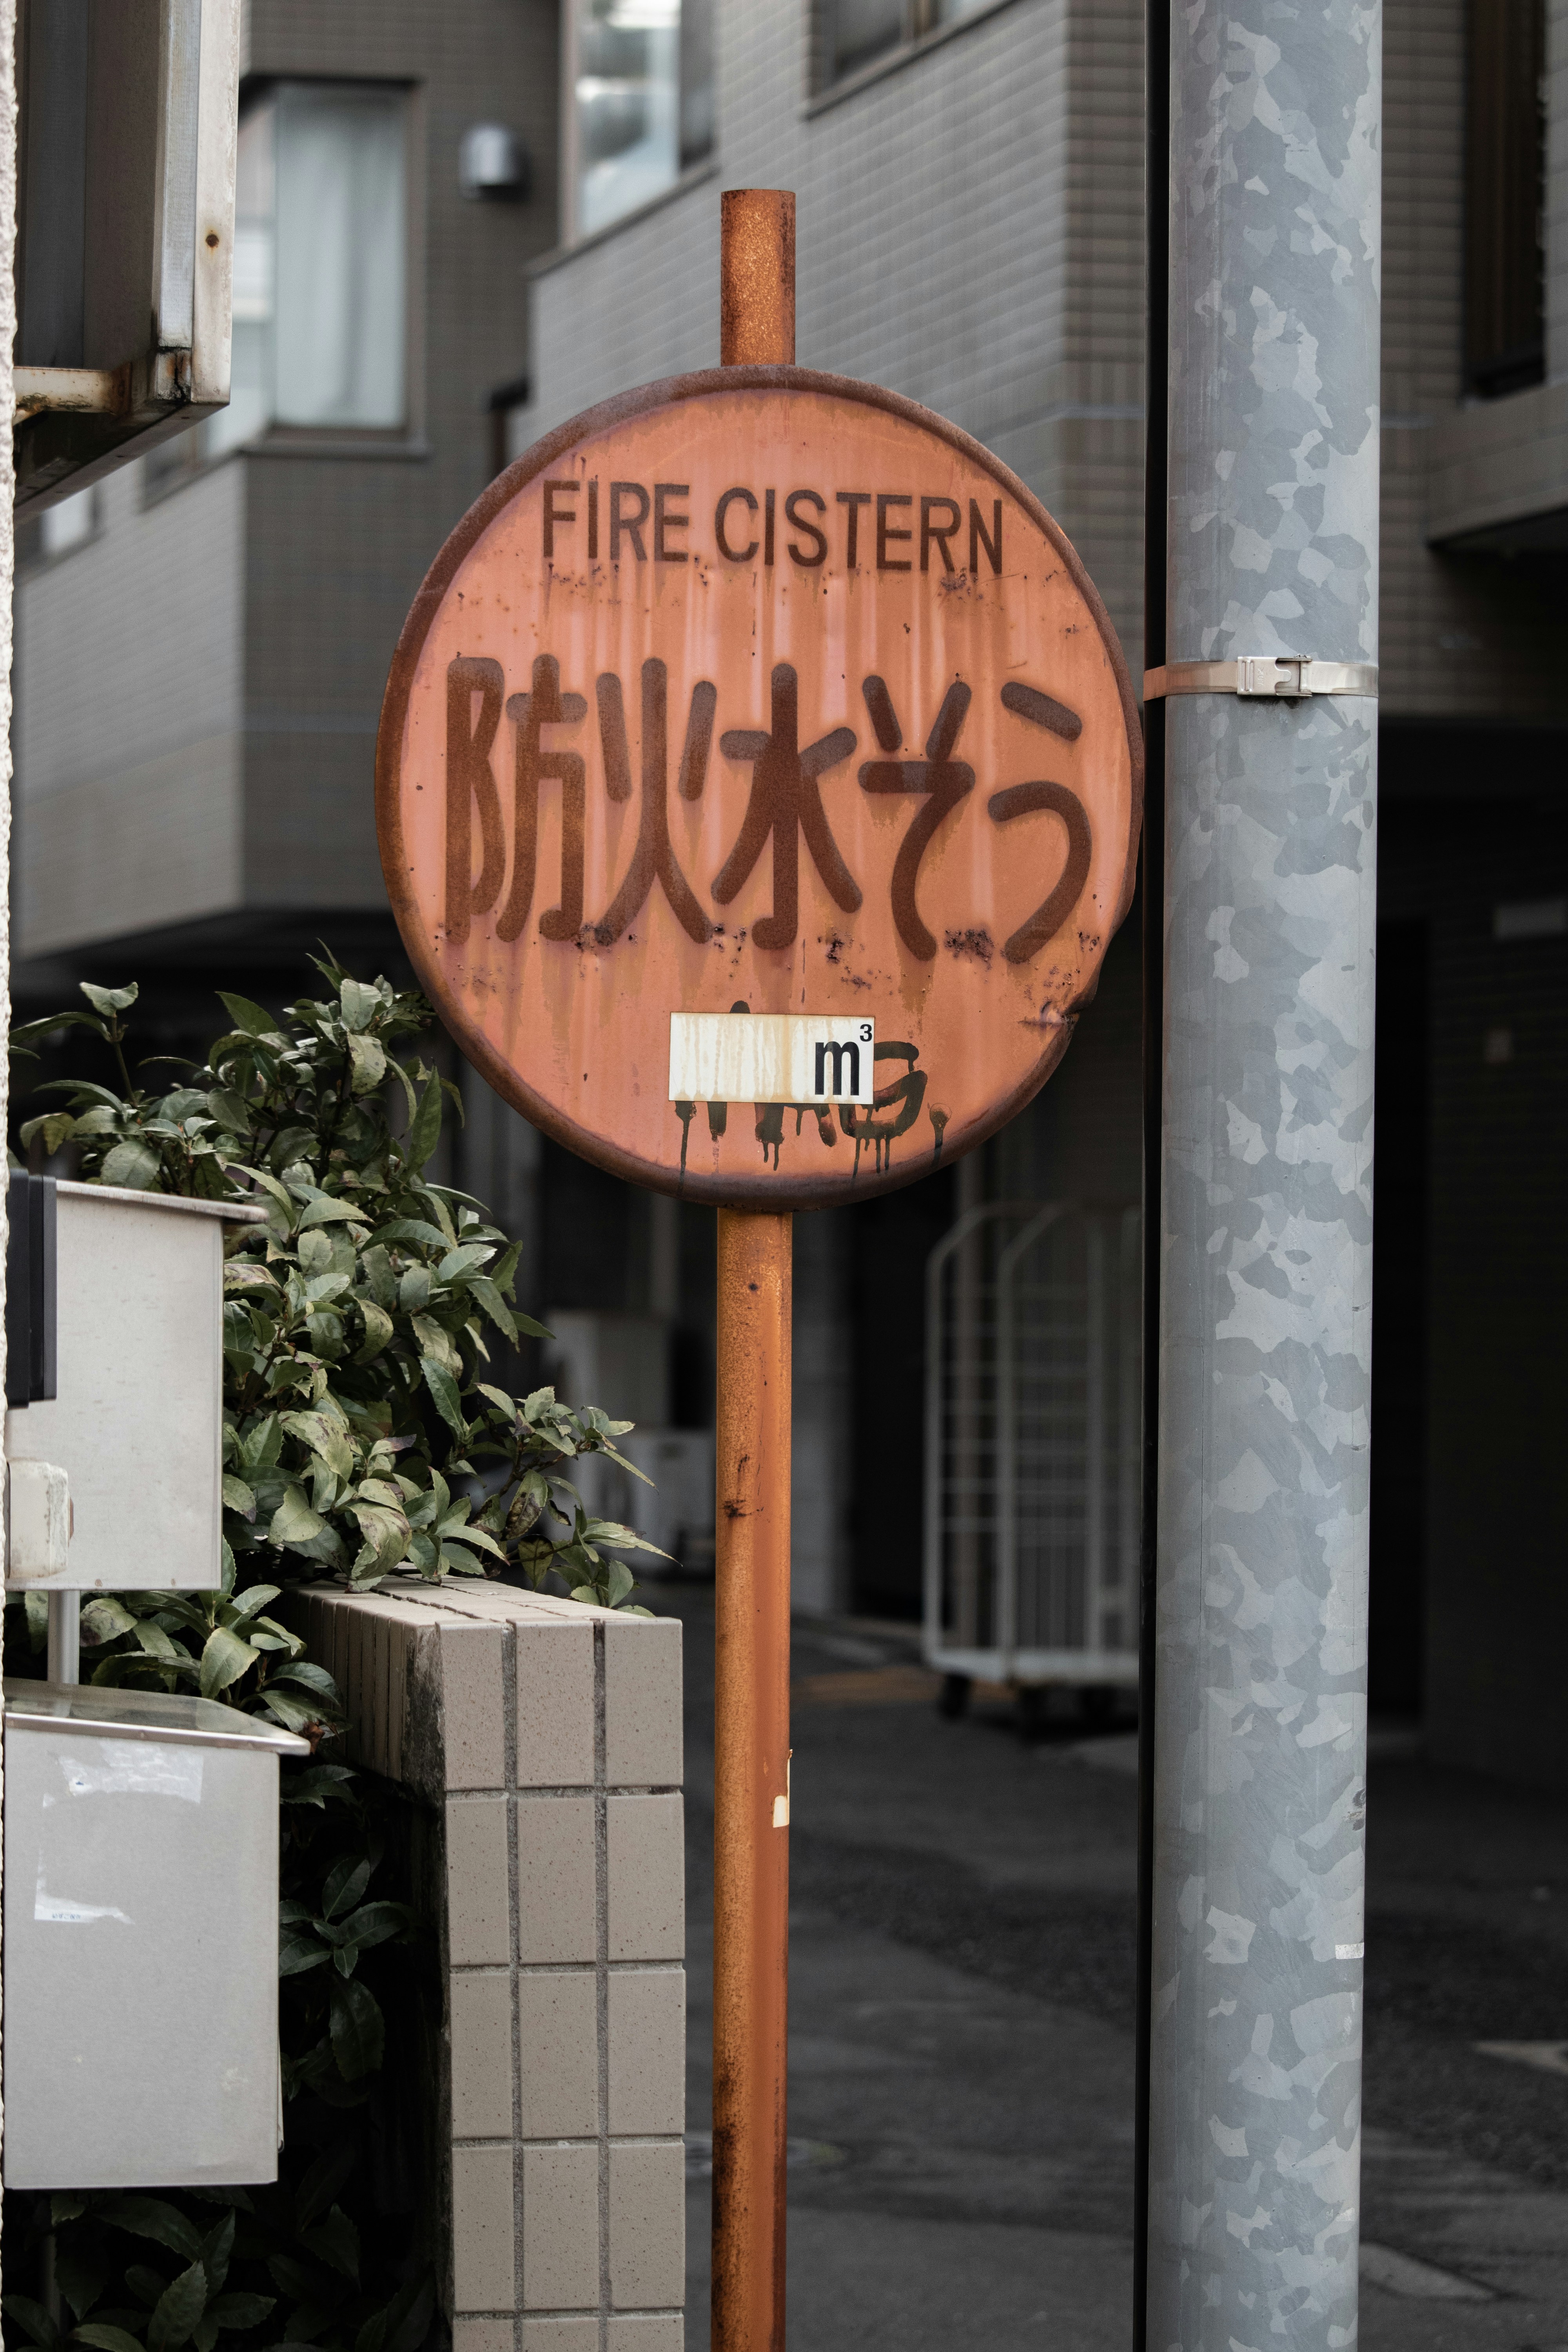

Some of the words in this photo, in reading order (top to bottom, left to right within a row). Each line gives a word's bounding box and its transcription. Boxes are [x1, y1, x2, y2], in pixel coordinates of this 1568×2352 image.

[543, 479, 689, 562] FIRE
[715, 487, 1002, 574] CISTERN
[446, 653, 1092, 963] 防火水そう
